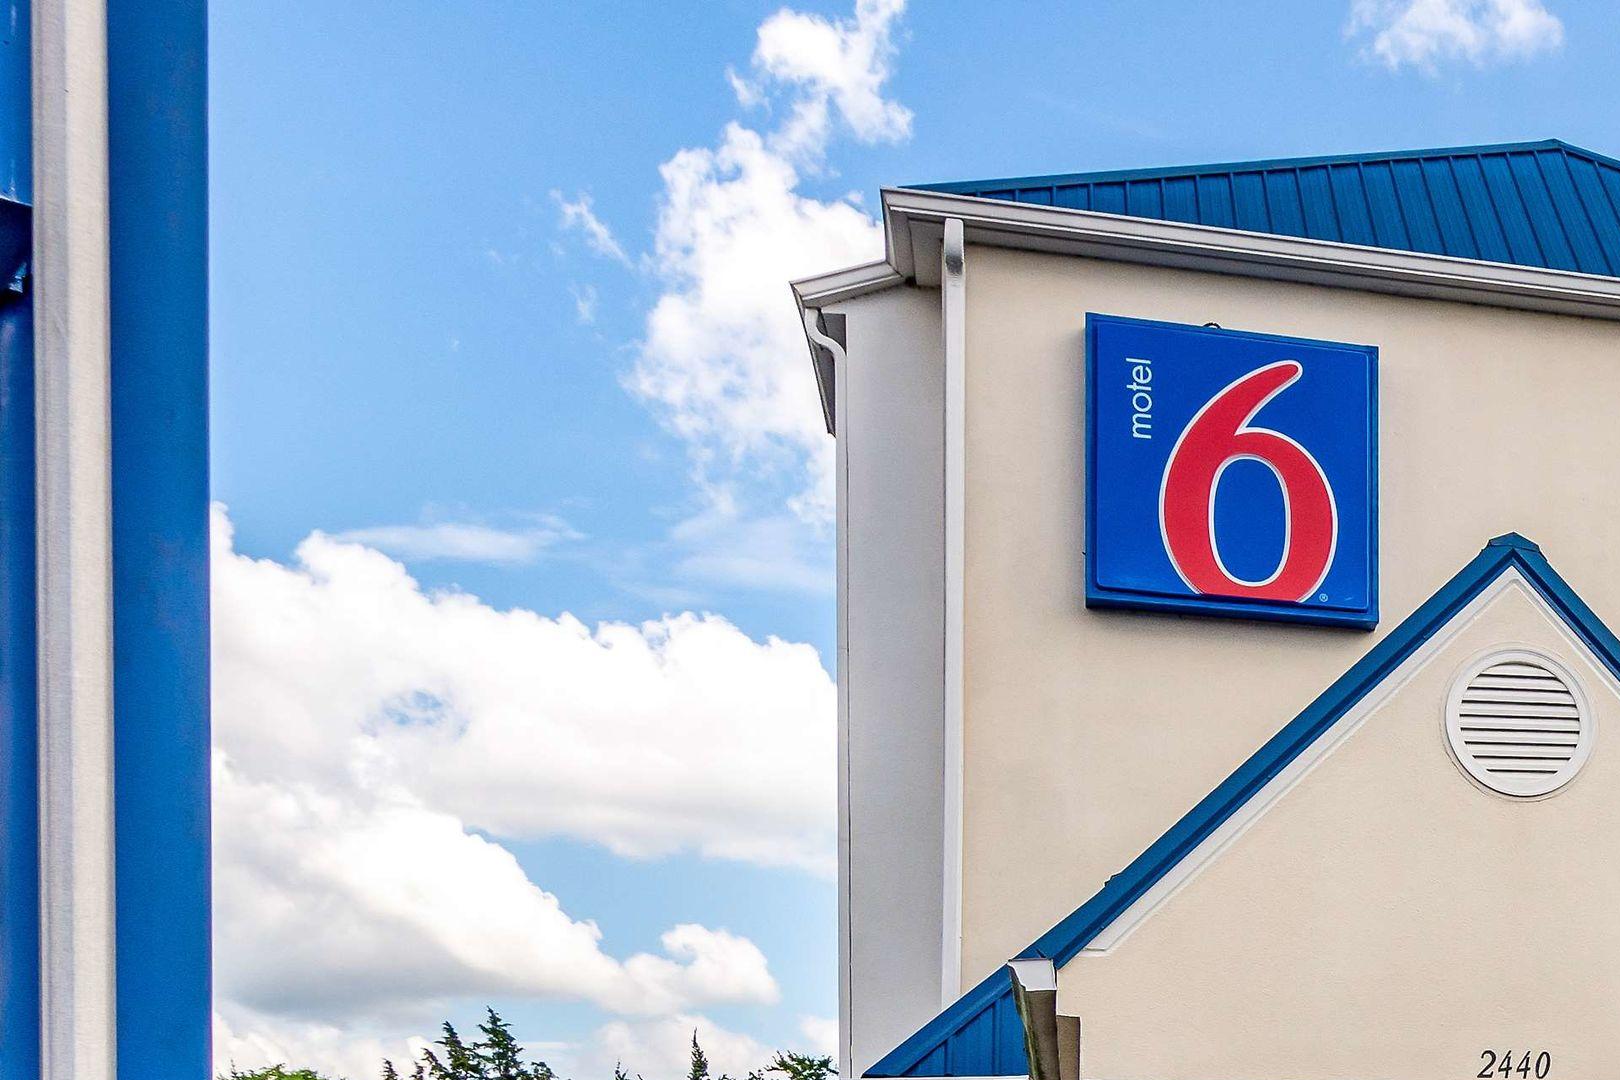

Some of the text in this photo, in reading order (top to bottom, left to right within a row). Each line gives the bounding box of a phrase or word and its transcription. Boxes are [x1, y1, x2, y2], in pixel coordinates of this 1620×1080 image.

[1126, 357, 1153, 440] motel
[1158, 359, 1339, 604] 6
[1476, 1050, 1551, 1080] 2440
